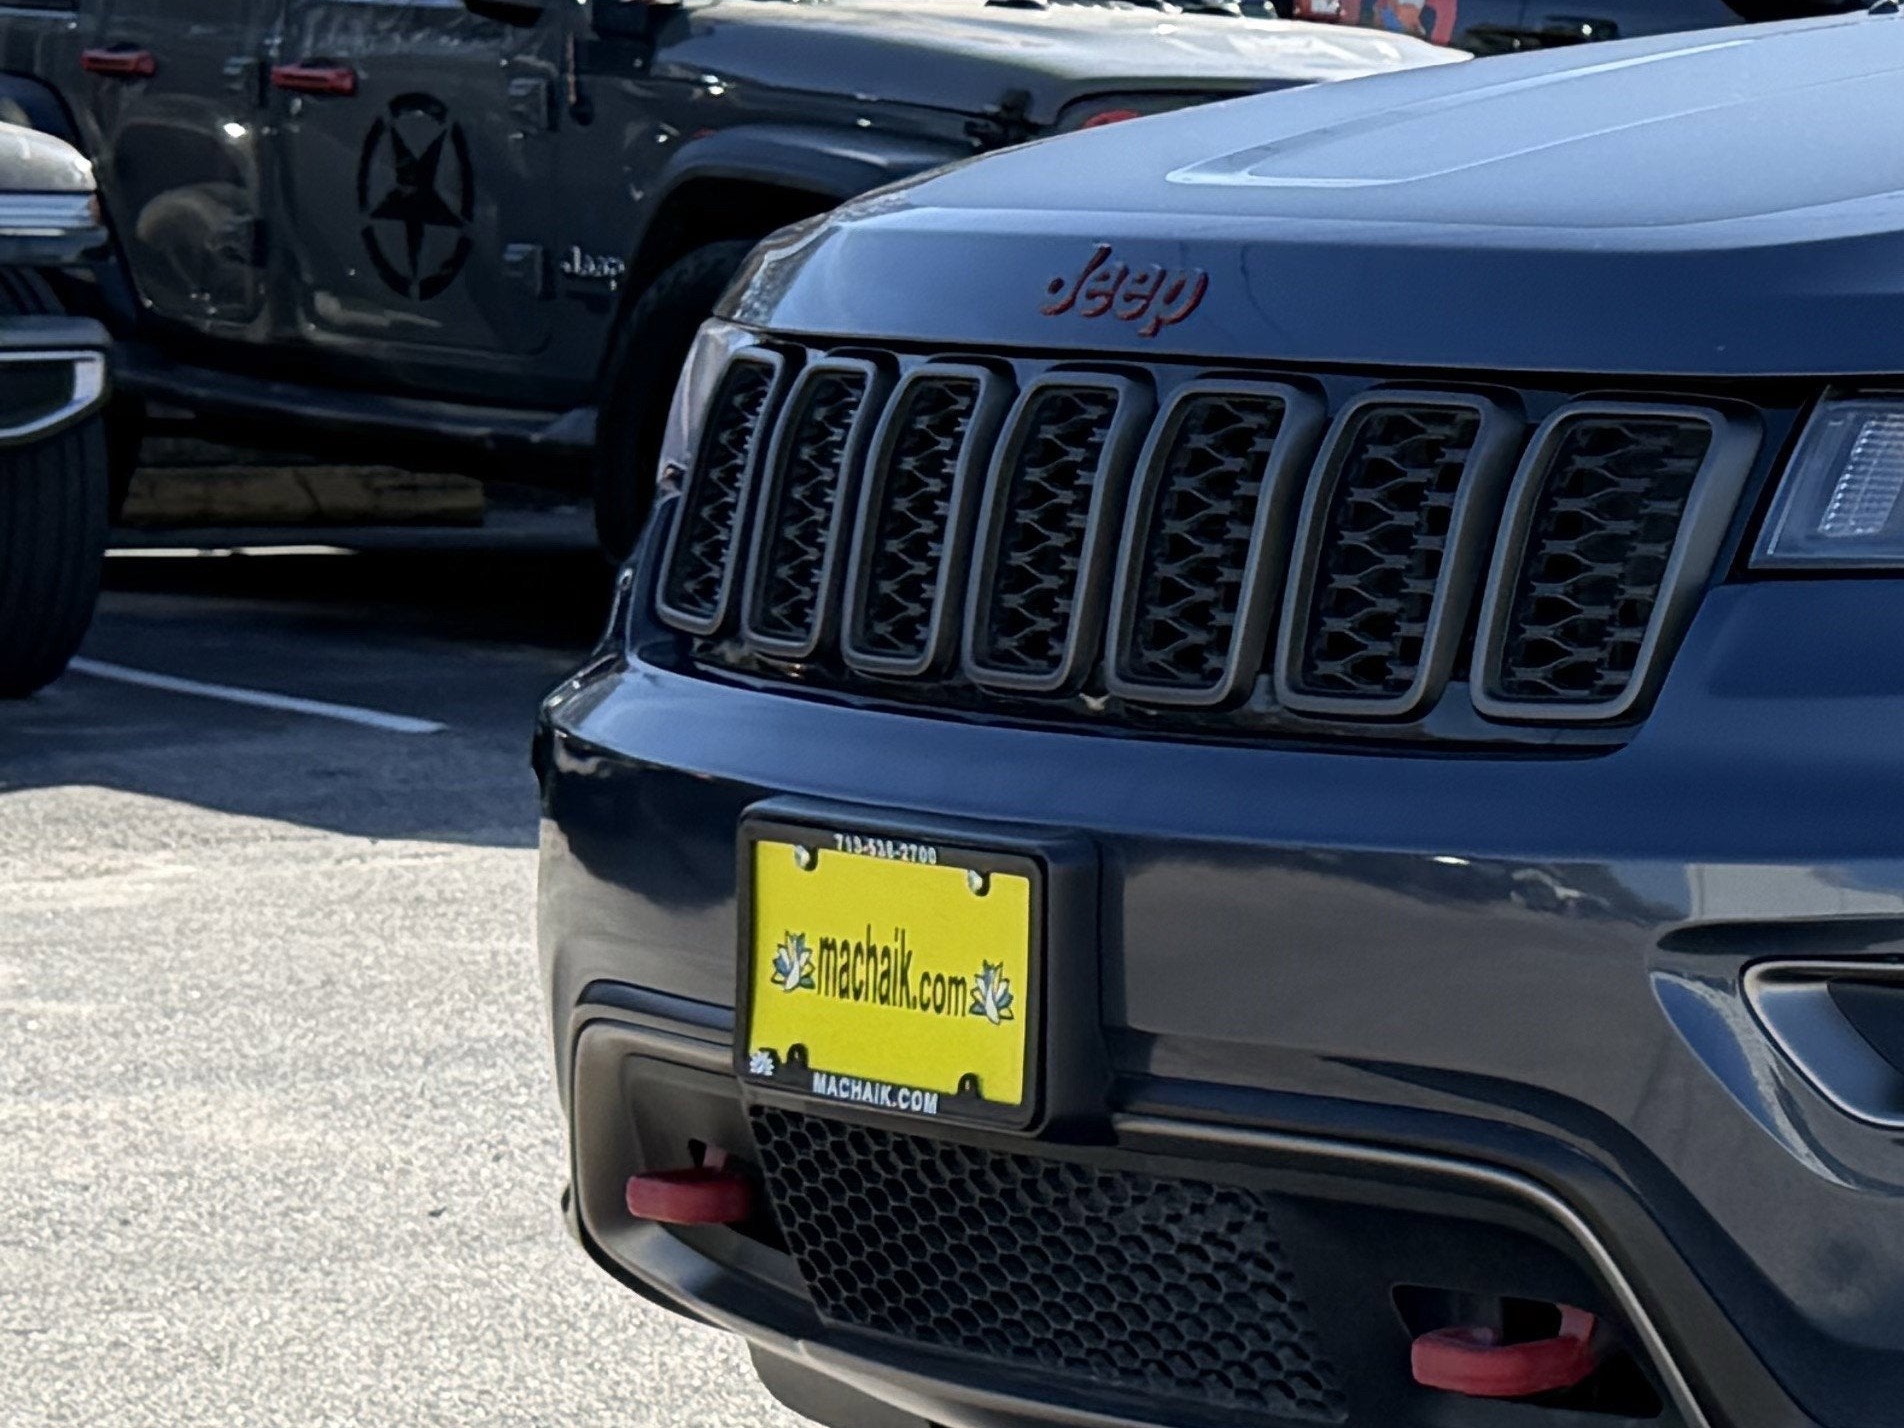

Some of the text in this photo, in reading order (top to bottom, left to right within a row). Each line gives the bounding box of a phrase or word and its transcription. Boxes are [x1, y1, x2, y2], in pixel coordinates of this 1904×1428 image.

[559, 244, 626, 292] Jeep
[1041, 241, 1209, 339] Jeep
[816, 922, 968, 1018] machaik.com
[811, 1071, 939, 1115] MACHAIK.COM
